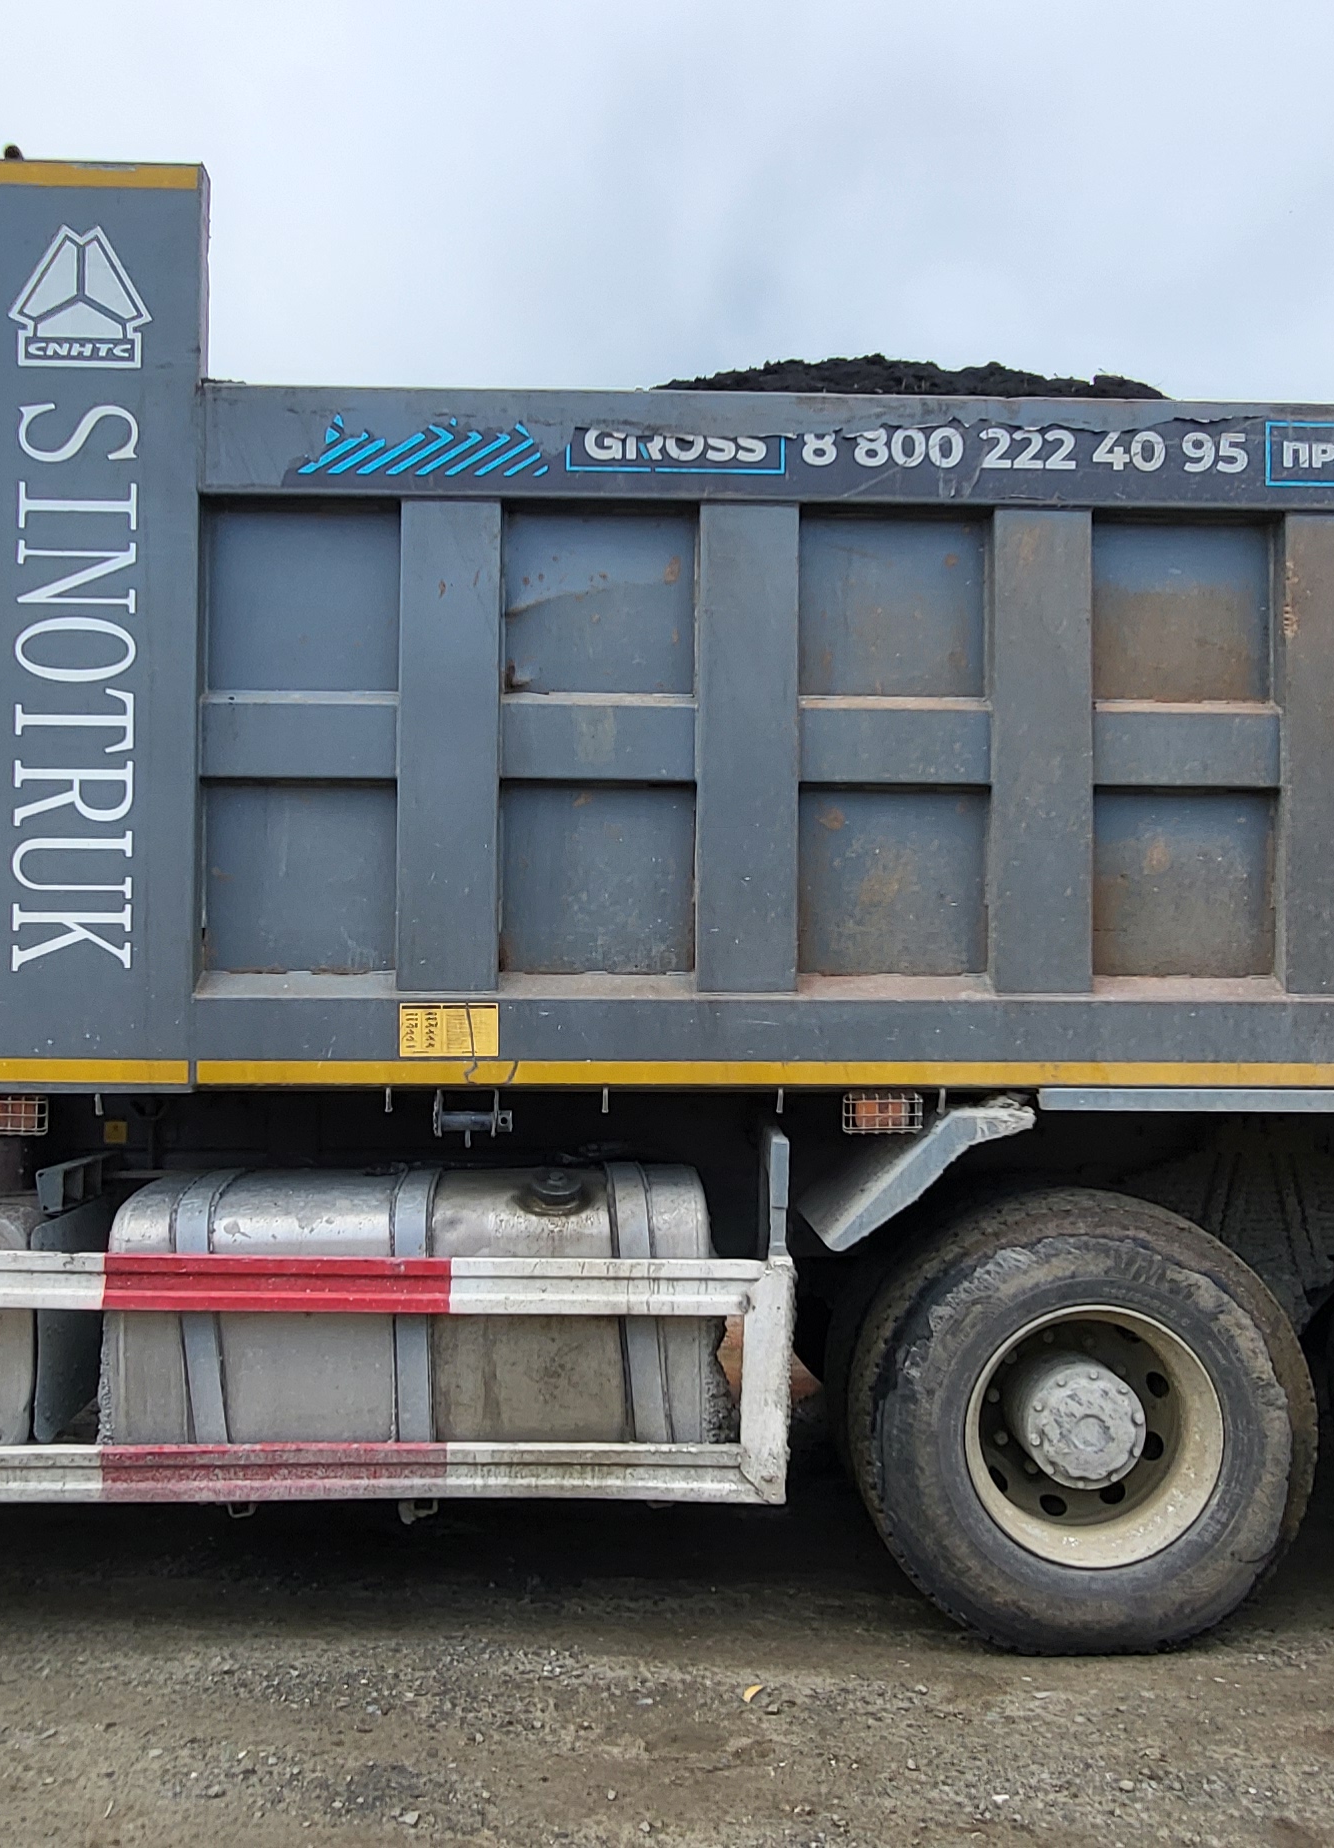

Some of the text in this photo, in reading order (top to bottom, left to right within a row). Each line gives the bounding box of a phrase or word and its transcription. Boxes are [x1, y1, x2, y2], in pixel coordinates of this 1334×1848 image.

[27, 342, 132, 358] CNHTC
[584, 427, 768, 463] GROSS
[801, 426, 1250, 474] 8 800 222 40 95
[10, 402, 140, 973] SINOTRUK
